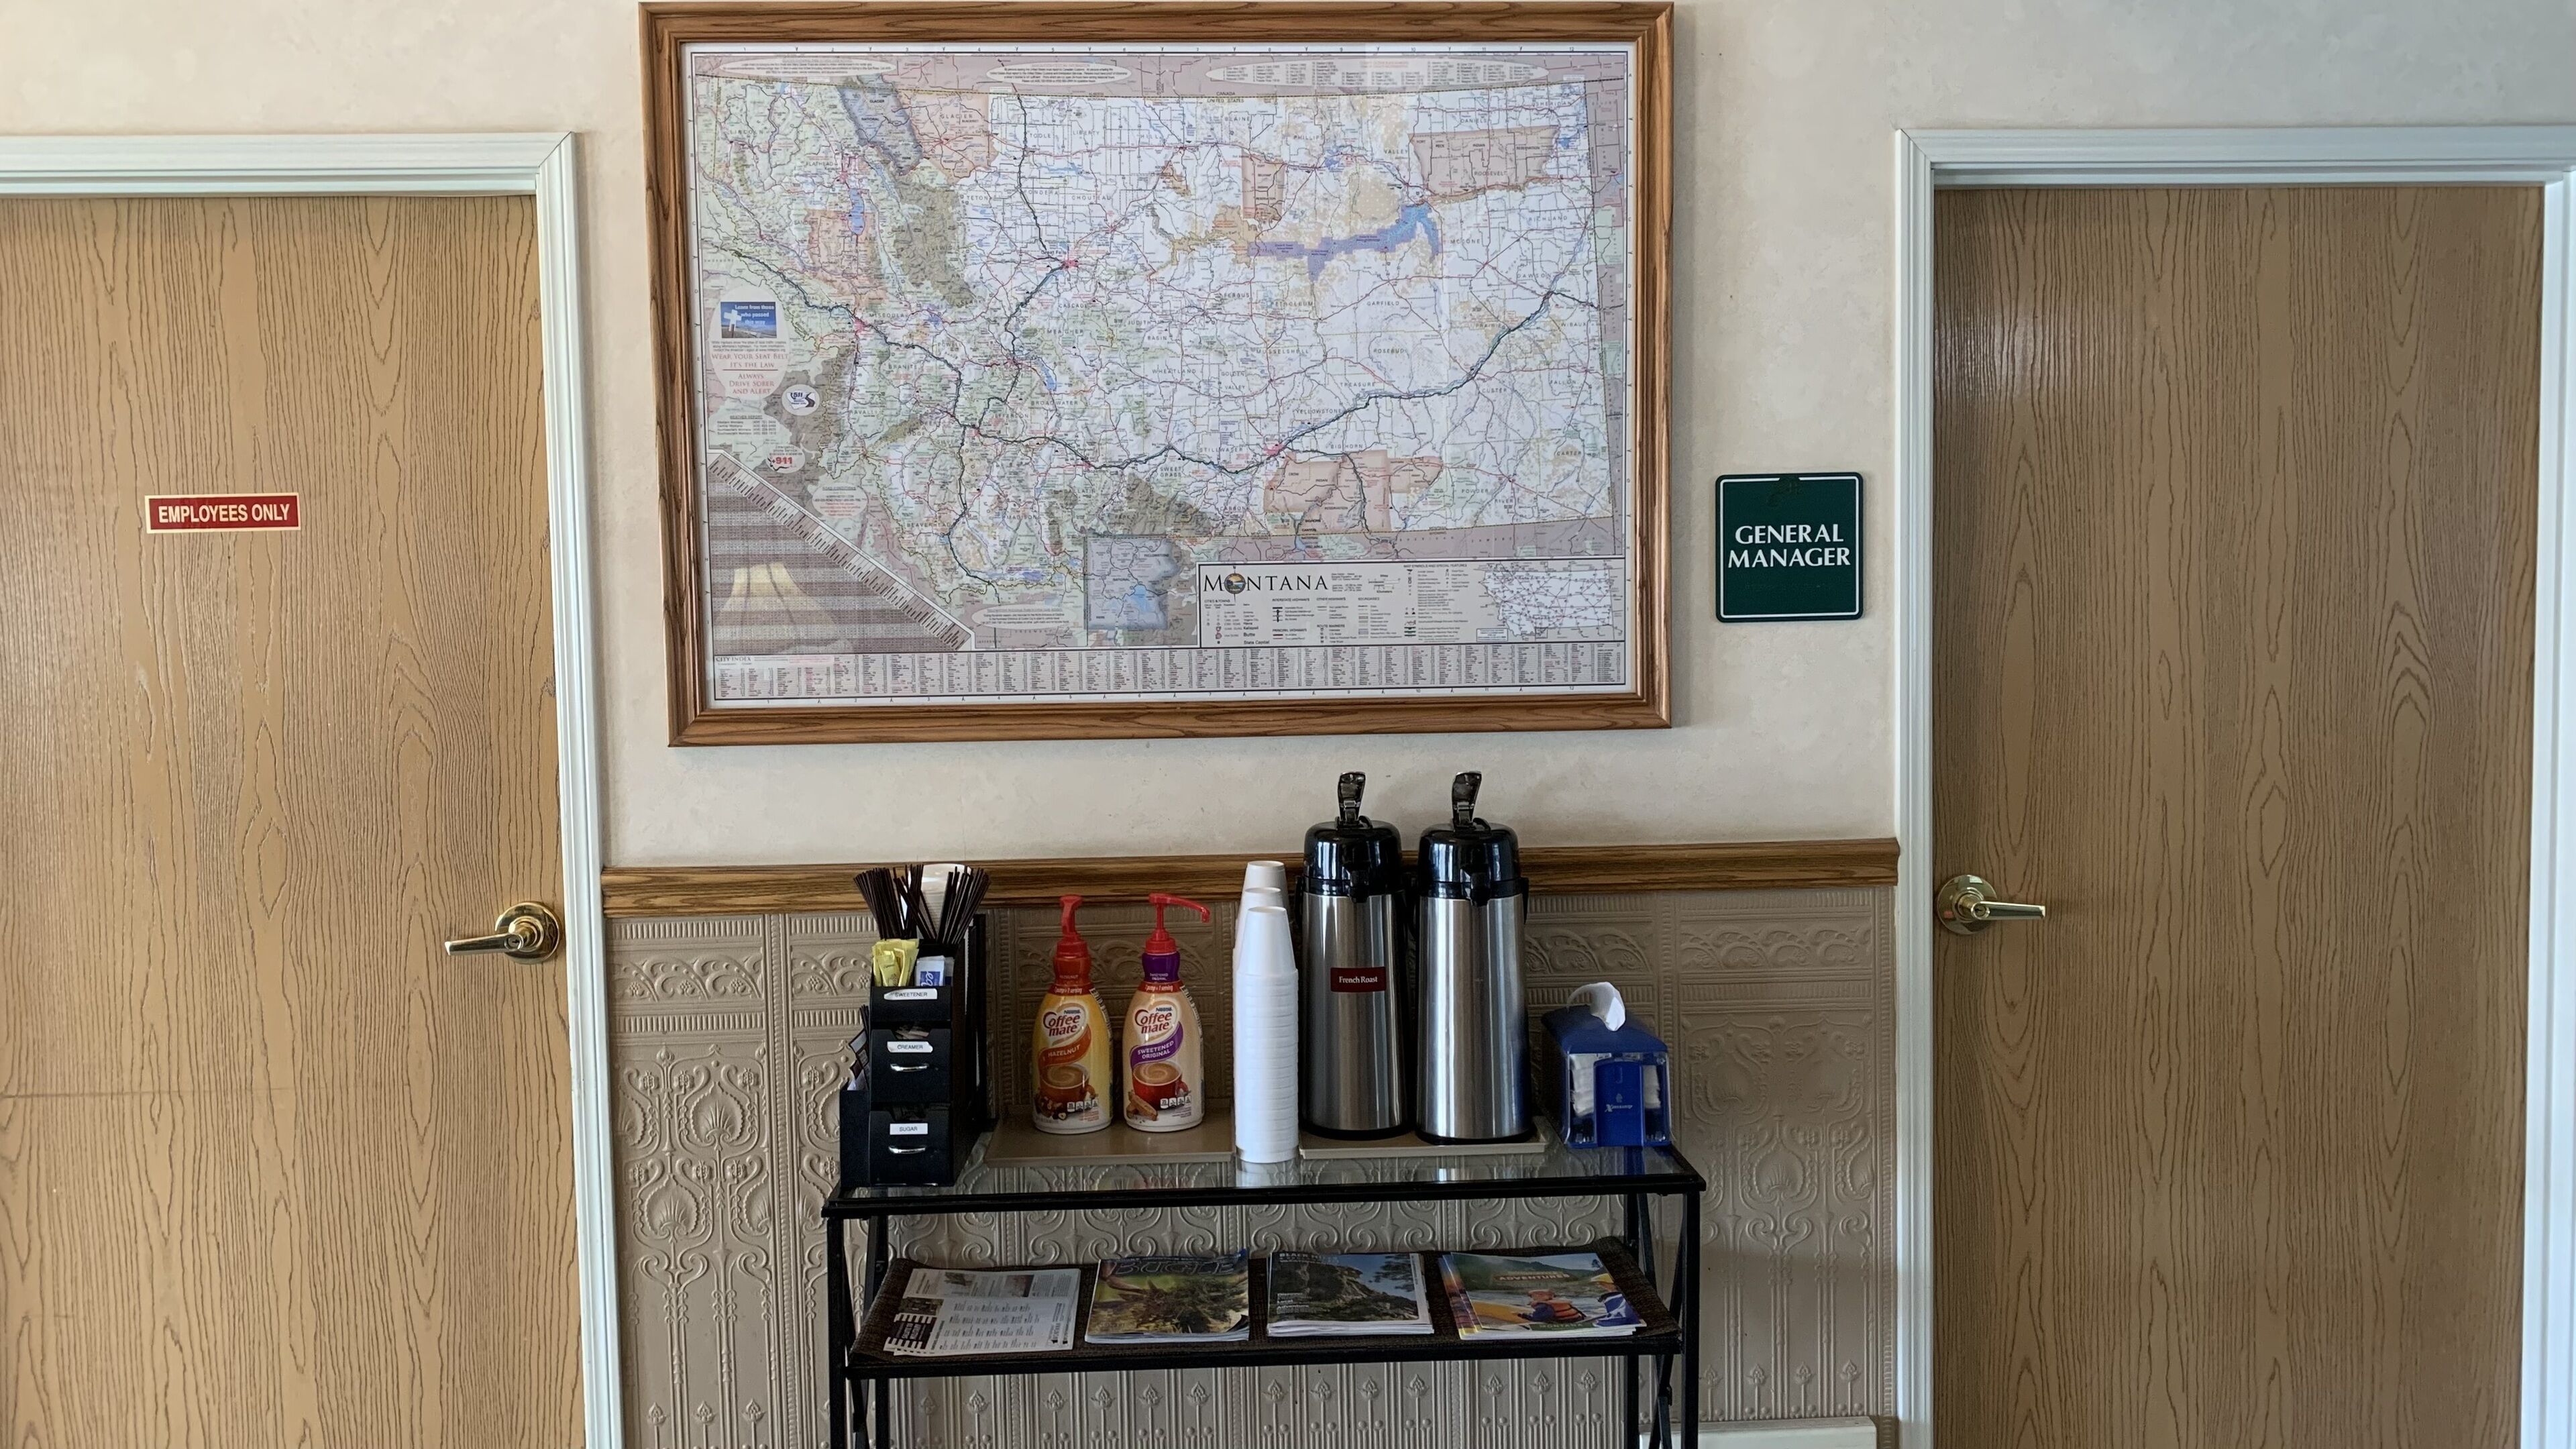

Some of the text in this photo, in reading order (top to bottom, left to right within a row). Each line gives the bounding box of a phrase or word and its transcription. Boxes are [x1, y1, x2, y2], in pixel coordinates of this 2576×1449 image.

[158, 504, 290, 523] EMPLOYEES ONLY
[1735, 524, 1844, 544] GENERAL
[1728, 547, 1850, 568] MANAGER
[1203, 574, 1329, 592] MONTANA
[1043, 1012, 1080, 1028] Coffee
[1135, 1009, 1172, 1026] Coffee
[1049, 1024, 1077, 1036] mate
[1141, 1022, 1169, 1034] mate
[1048, 1044, 1080, 1058] HAZELNUT
[1138, 1040, 1174, 1055] SWEETENED
[1142, 1050, 1171, 1059] ORIGINAL
[1111, 1260, 1236, 1275] BUGLE
